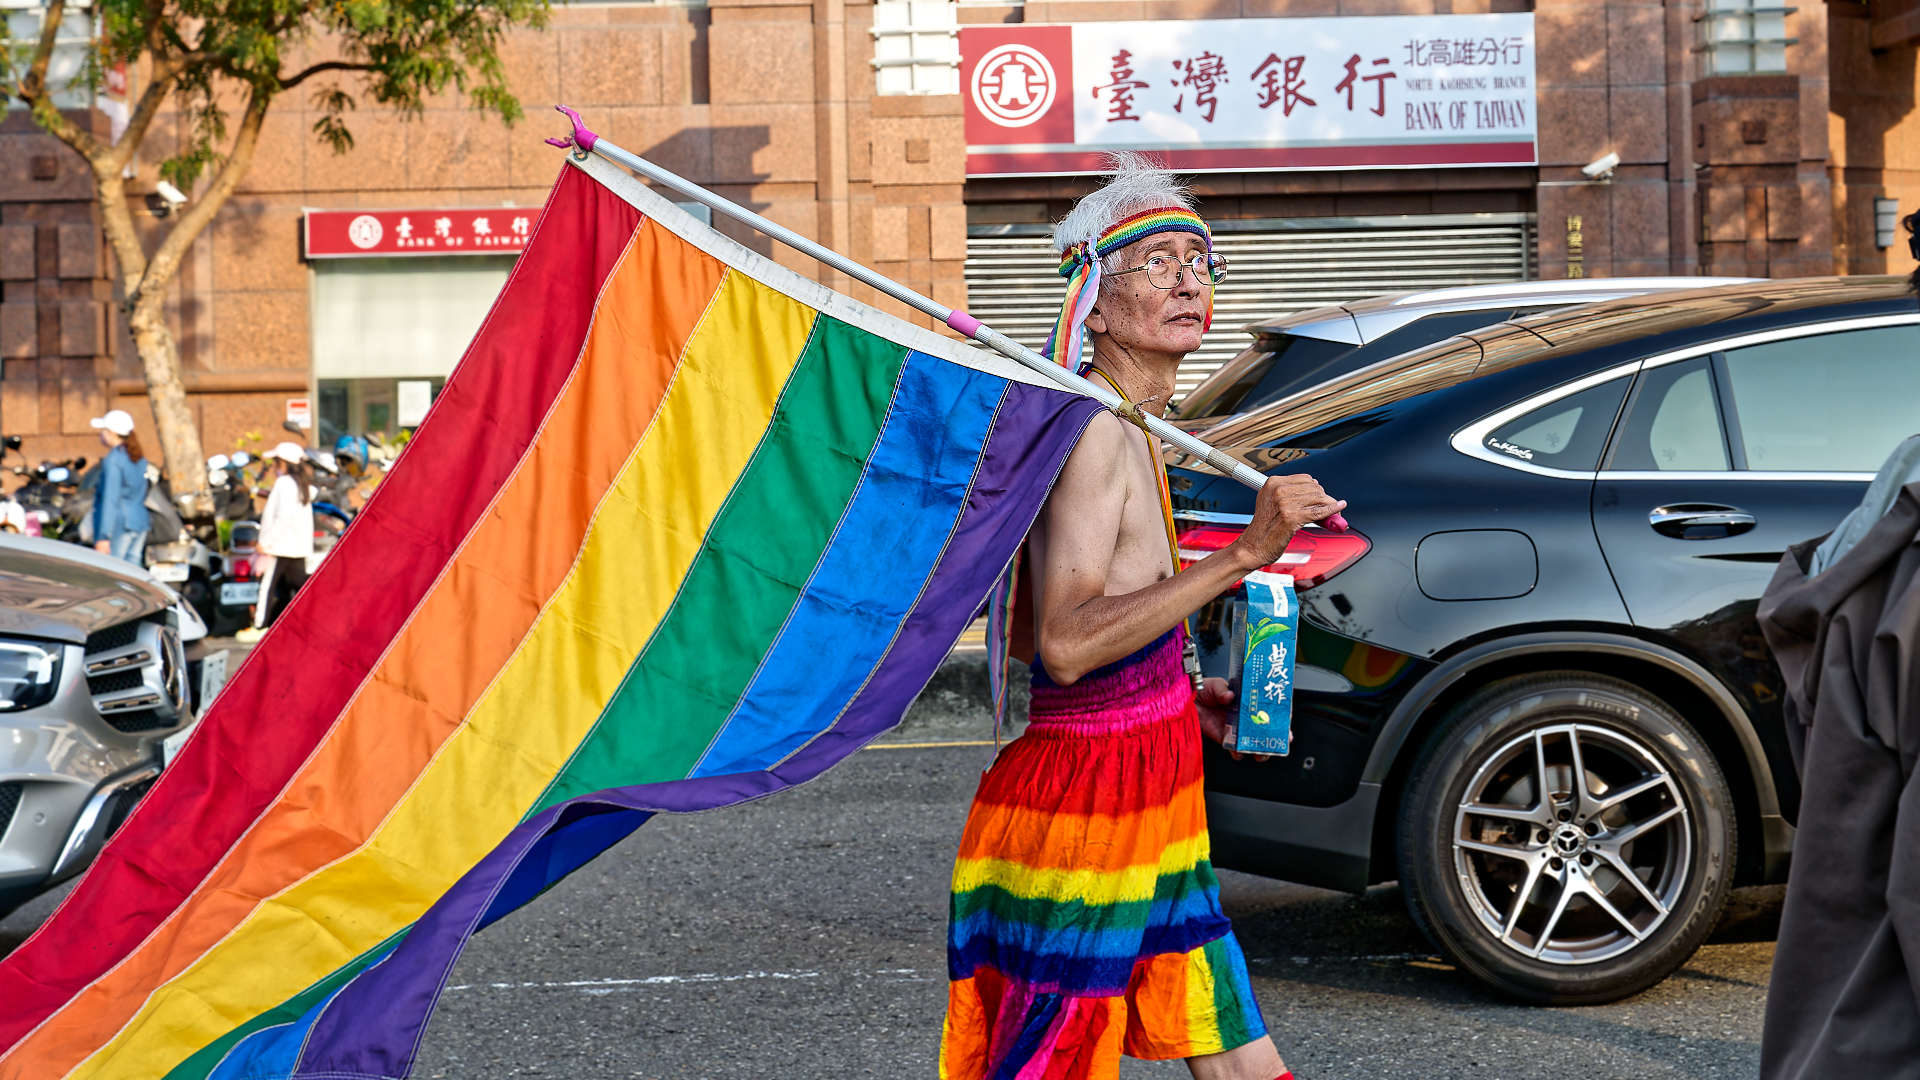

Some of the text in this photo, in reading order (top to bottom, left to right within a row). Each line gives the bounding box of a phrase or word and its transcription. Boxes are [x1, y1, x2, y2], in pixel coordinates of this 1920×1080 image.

[1403, 37, 1524, 66] 北高雄分行
[1092, 49, 1396, 123] 臺灣銀行
[1405, 78, 1432, 90] NORTH
[1494, 76, 1526, 88] BRANCH
[1405, 99, 1526, 130] BANK OF TAIWAN
[397, 237, 434, 248] BANK
[445, 237, 464, 247] OF
